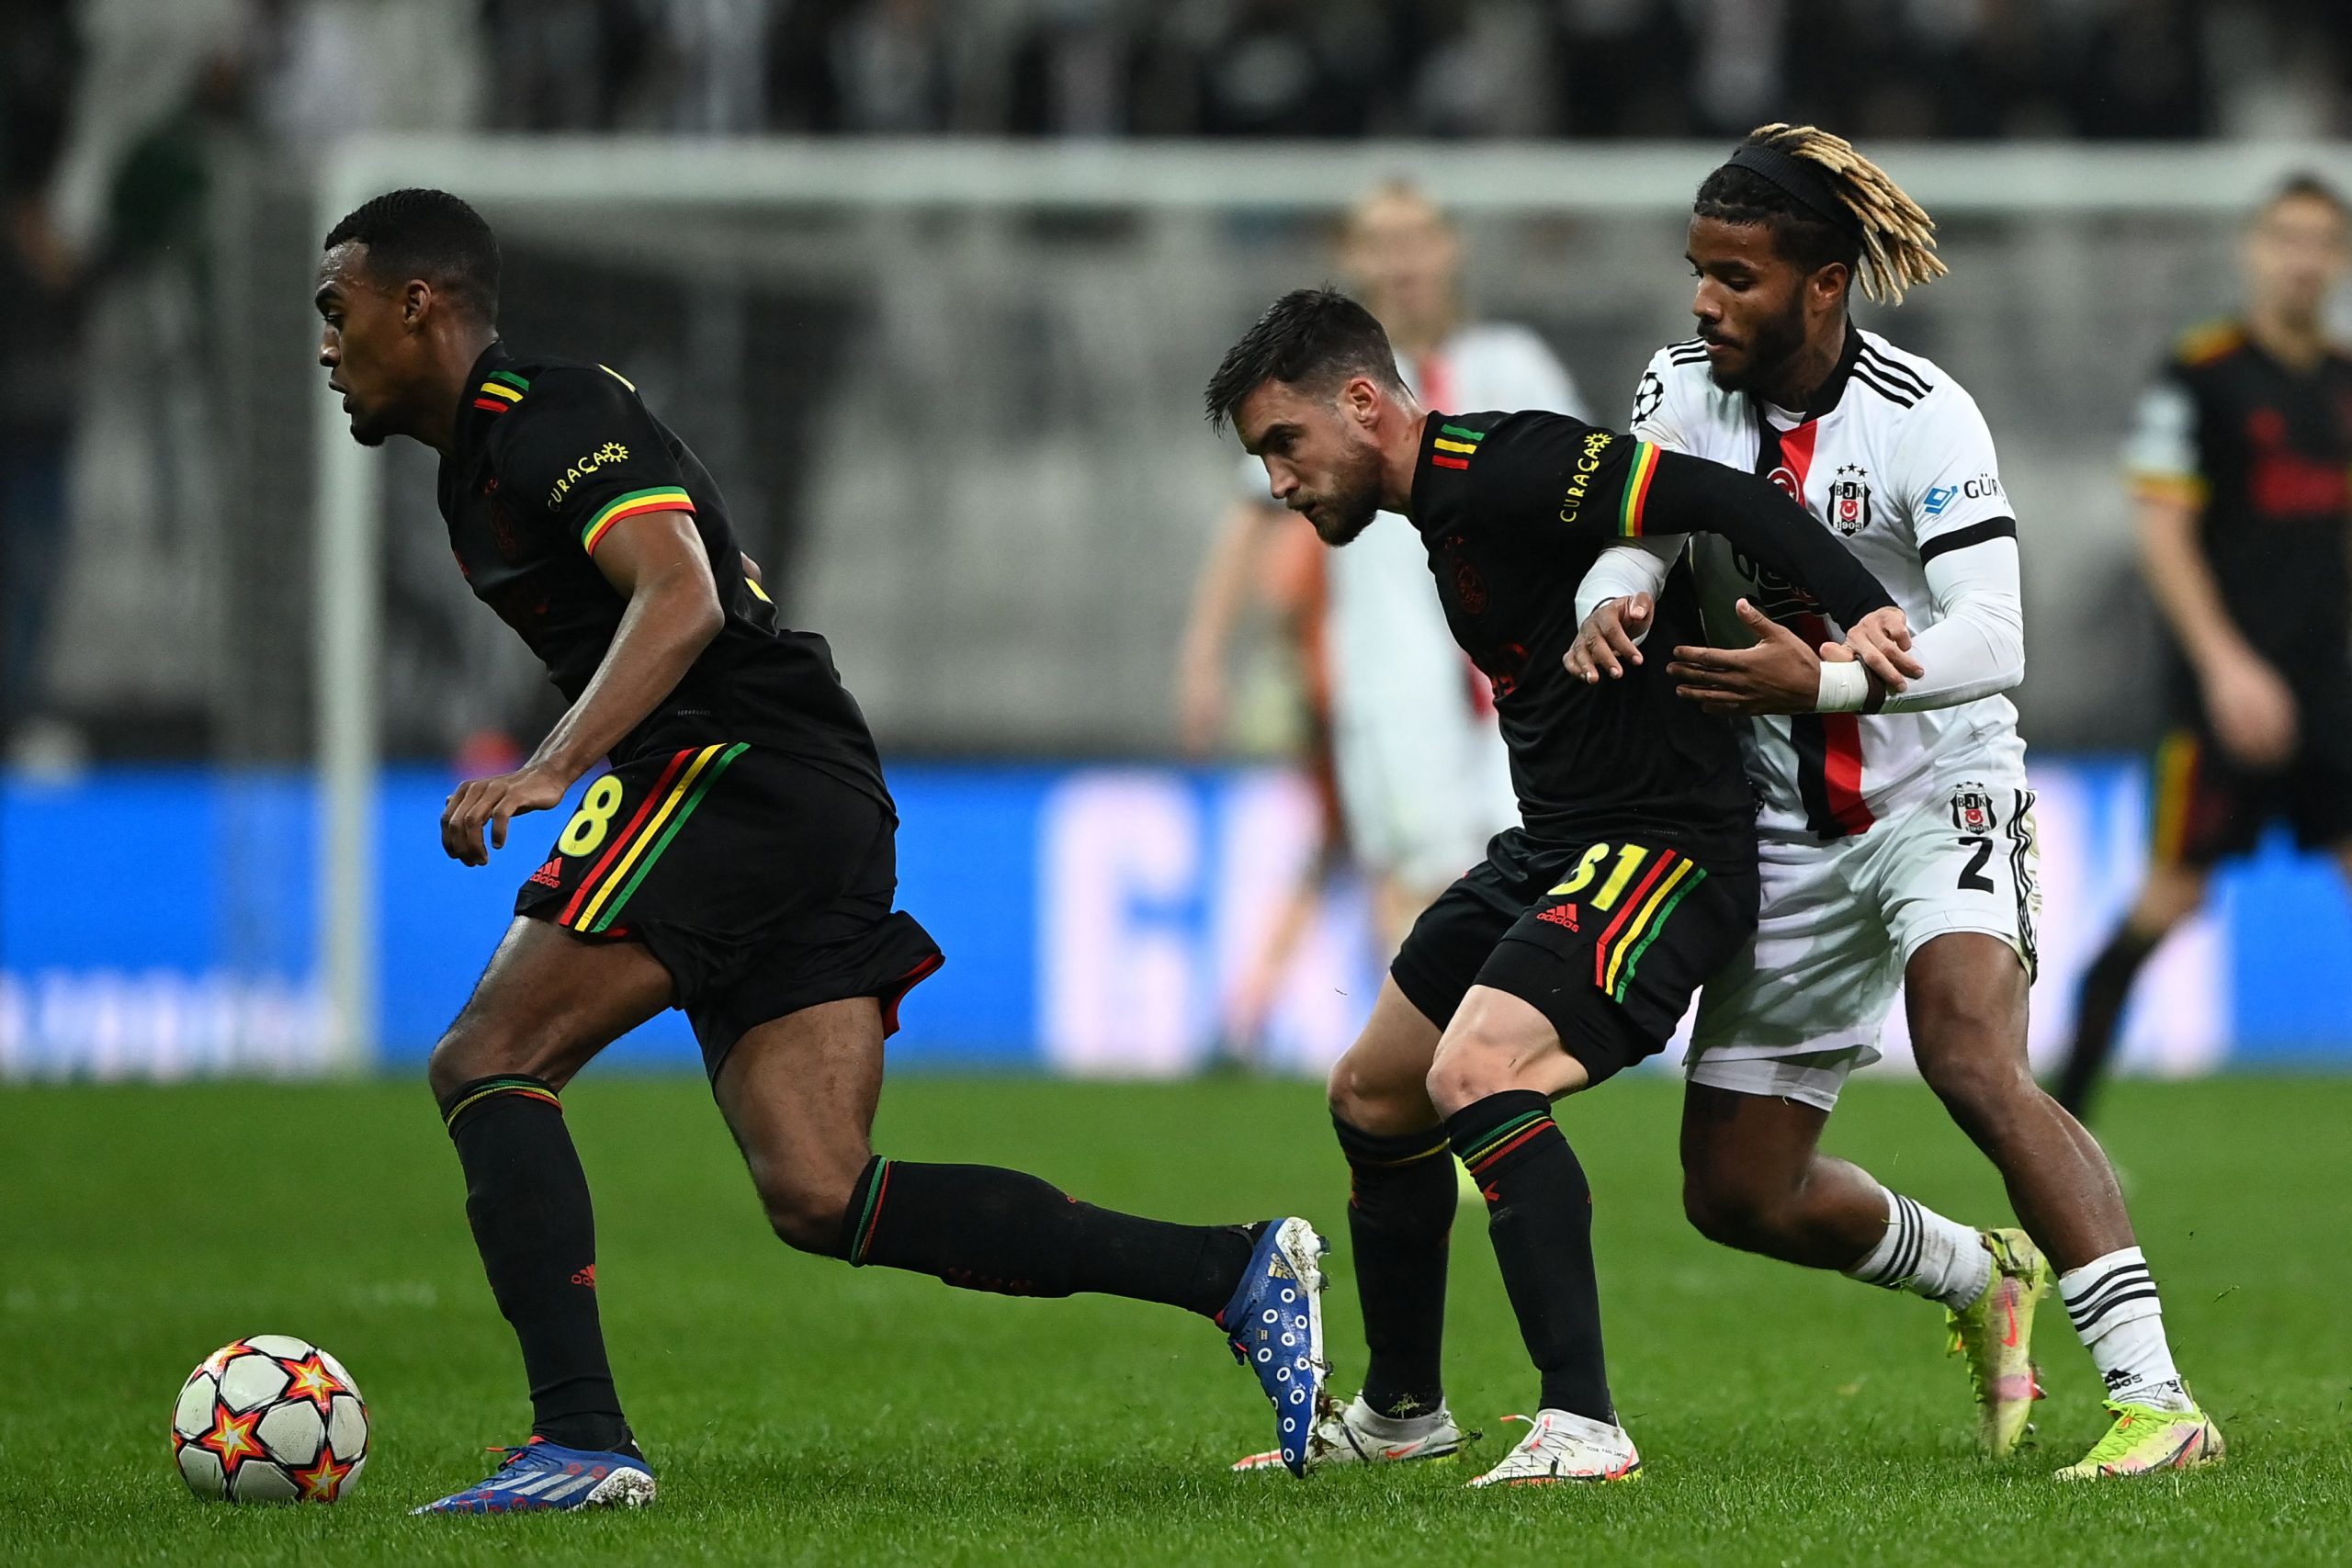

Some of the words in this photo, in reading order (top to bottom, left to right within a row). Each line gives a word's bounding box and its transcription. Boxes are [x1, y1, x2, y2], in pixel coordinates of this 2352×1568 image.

[1836, 485, 1863, 497] BJK
[1837, 522, 1862, 530] 1903
[1958, 797, 1985, 807] BJK
[559, 774, 623, 857] 8
[1957, 837, 1994, 895] 2
[1536, 912, 1579, 932] adidas
